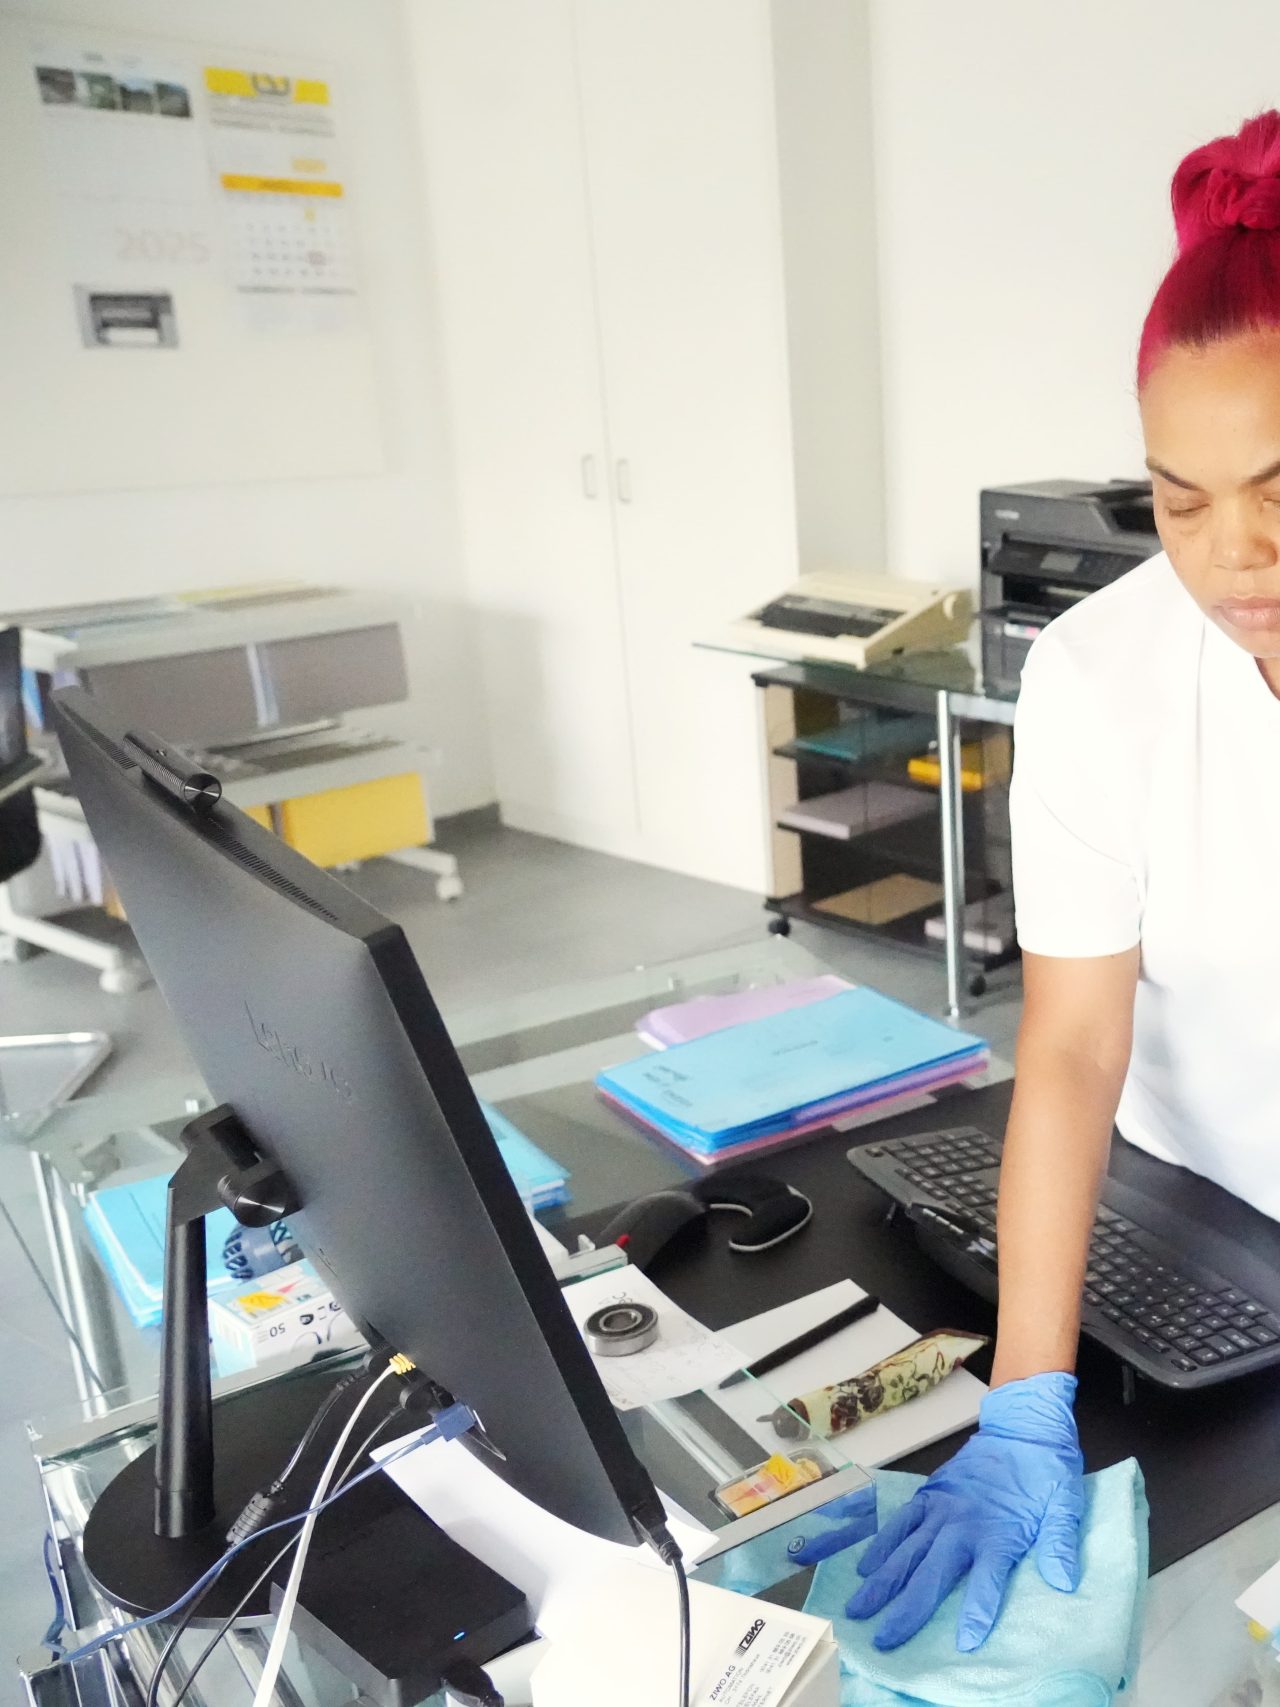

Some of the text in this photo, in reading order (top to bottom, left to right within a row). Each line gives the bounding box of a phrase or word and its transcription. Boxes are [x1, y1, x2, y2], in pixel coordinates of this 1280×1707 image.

[269, 1322, 286, 1338] 50
[743, 1618, 766, 1649] ZIWO
[709, 1664, 736, 1701] ZIWO AG
